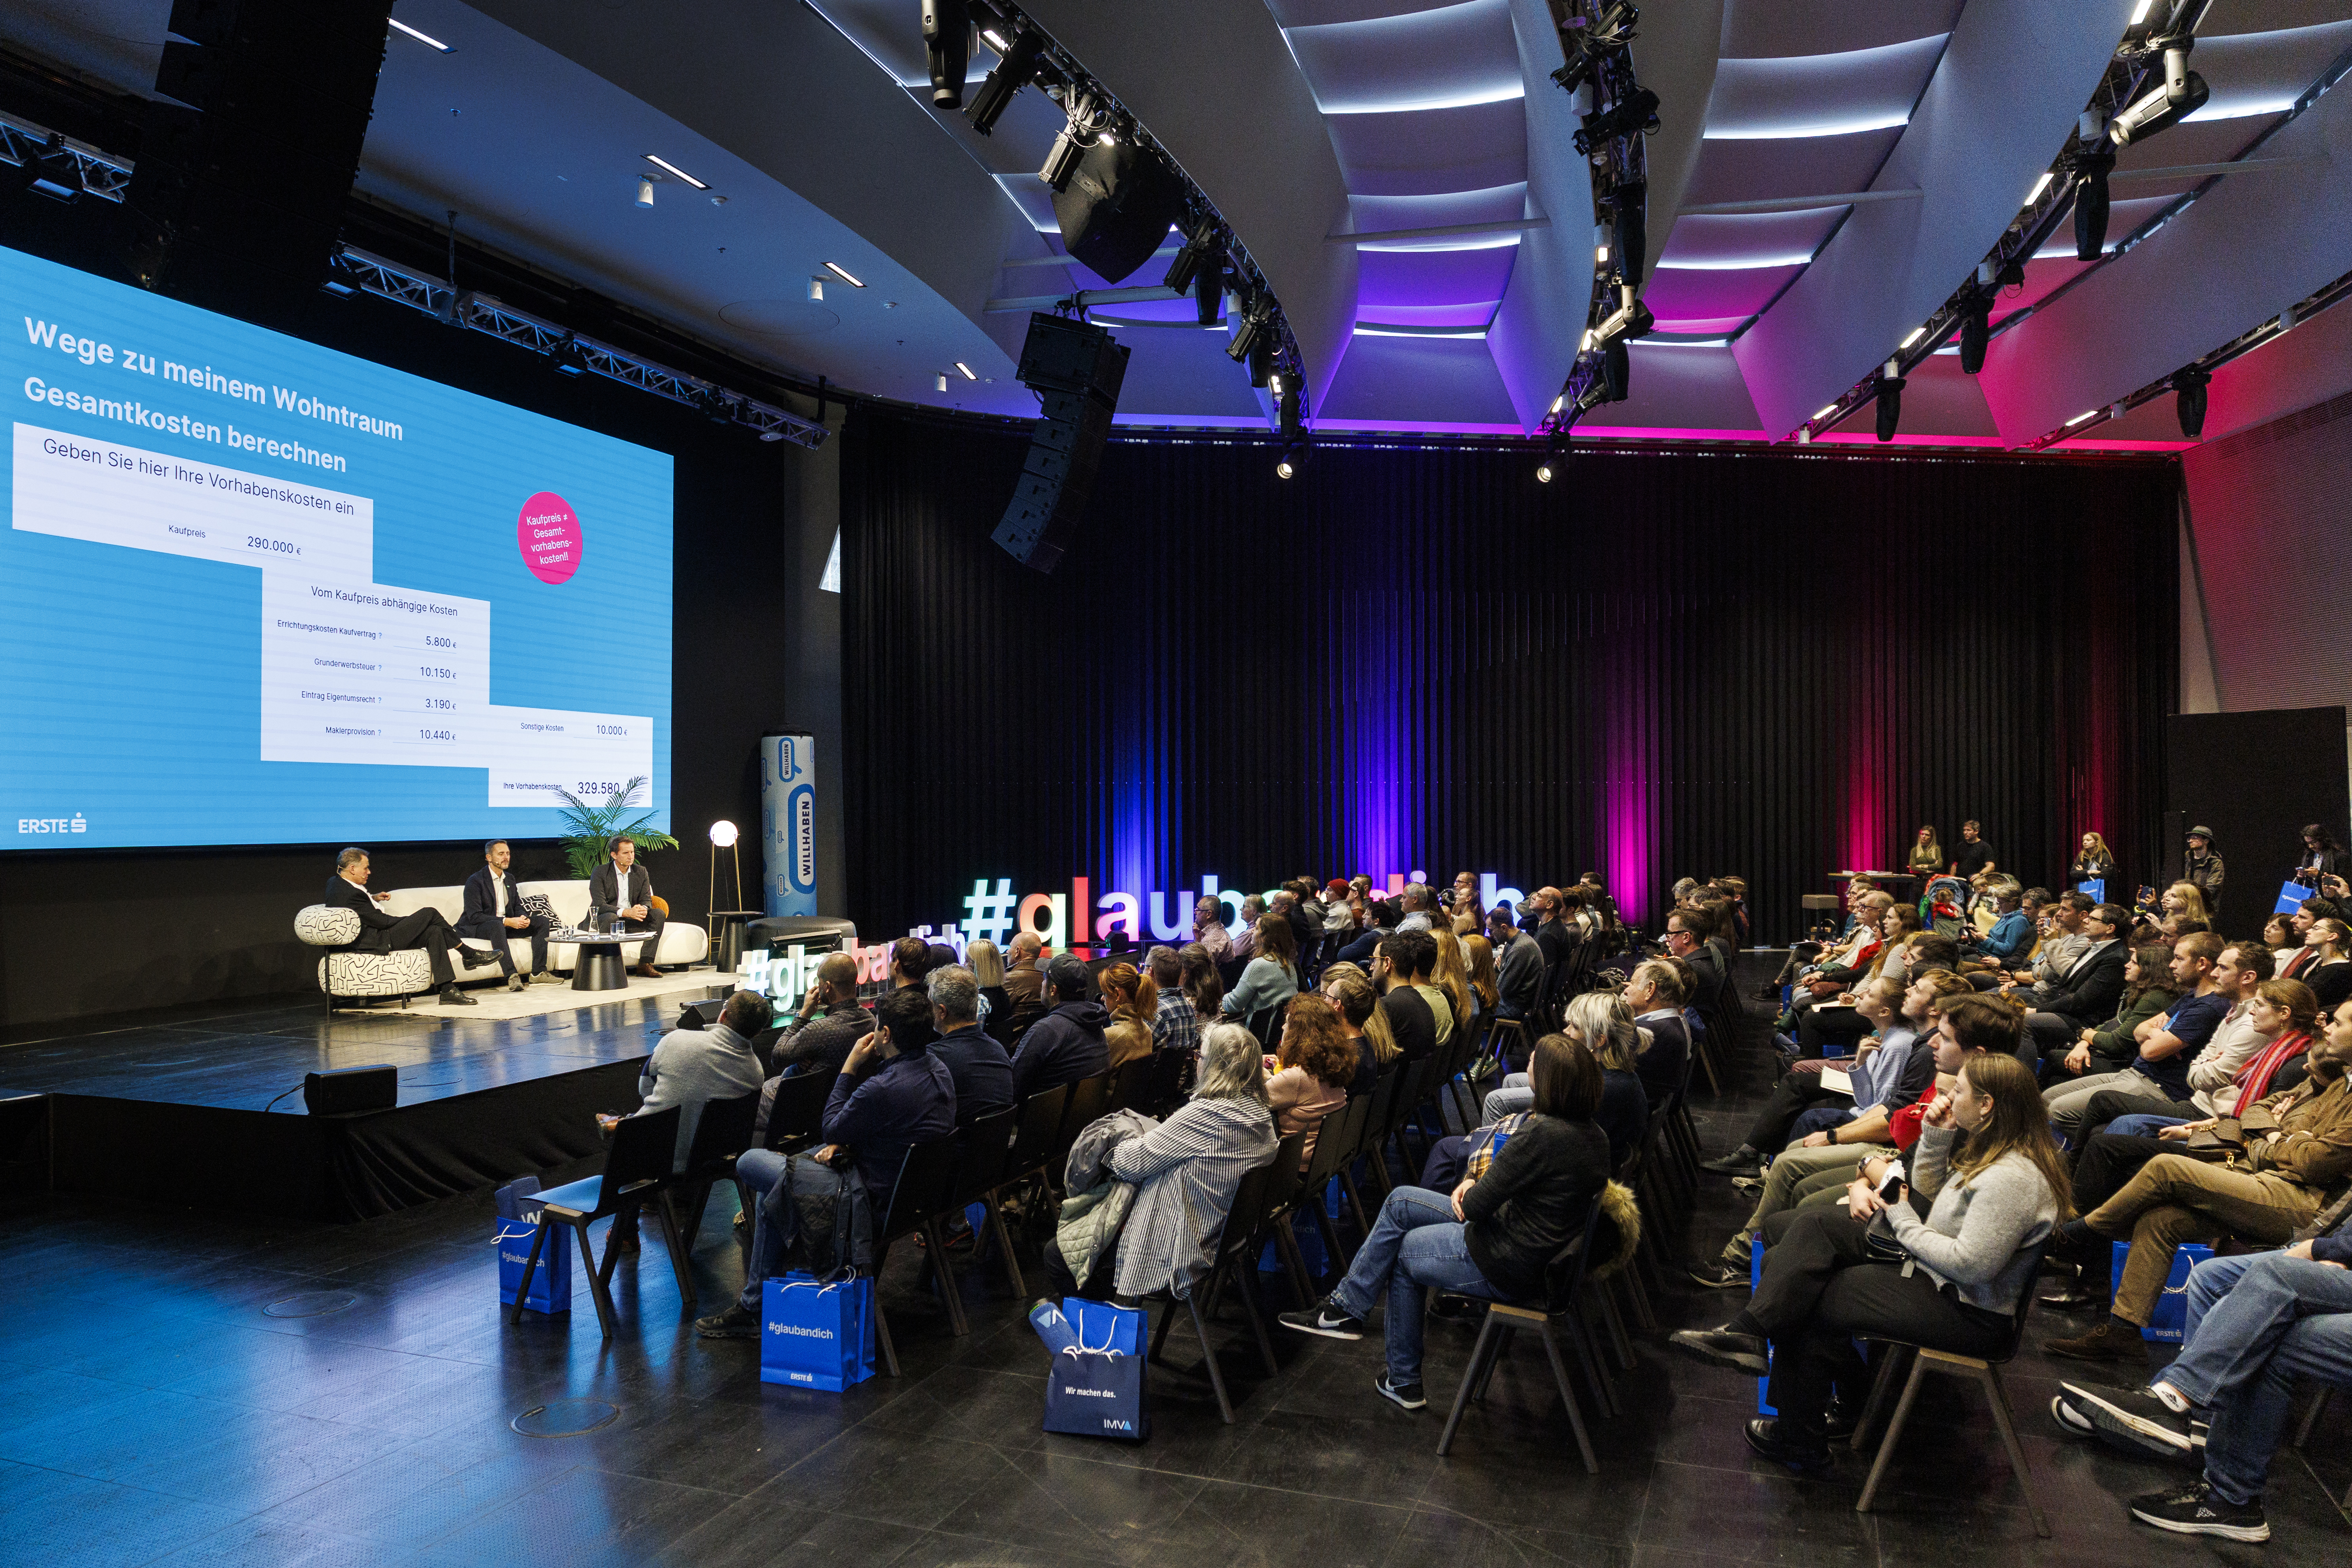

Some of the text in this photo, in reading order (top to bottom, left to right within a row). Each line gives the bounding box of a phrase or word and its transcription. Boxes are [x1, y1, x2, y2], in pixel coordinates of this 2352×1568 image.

[25, 317, 402, 440] Wege zu meinem Wohntraum
[25, 377, 345, 472] Gesamtkosten berechnen
[44, 439, 353, 515] Geben Sie hier Ihre Vorhabenskosten ein
[527, 513, 561, 525] Kaufpreis
[169, 525, 205, 538] Kaufpreis
[248, 537, 293, 553] 290.000
[534, 527, 565, 538] Gesamt-
[531, 540, 572, 552] vorhabens-
[540, 552, 568, 564] kosten!!
[312, 586, 457, 616] Vom Kaufpreis abhängige Kosten
[278, 620, 337, 633] Errichtungskosten
[340, 628, 375, 640] Kaufvertrag
[426, 636, 451, 648] 5.800
[315, 658, 375, 670] Grunderwerbsteuer
[421, 667, 450, 678] 10.150
[302, 691, 324, 701] Eintrag
[327, 693, 375, 703] Eigentumsrecht
[426, 698, 450, 710] 3.190
[326, 727, 375, 737] Maklerprovision
[420, 730, 449, 740] 10.440
[521, 723, 544, 732] Sonstige
[597, 725, 622, 735] 10.000
[578, 782, 620, 794] 329.580
[19, 819, 68, 833] ERSTE
[802, 801, 811, 876] WILLHABEN
[769, 1322, 833, 1340] #glaubandich
[790, 1373, 807, 1382] ERSTE
[1065, 1387, 1116, 1398] Wir machen das.
